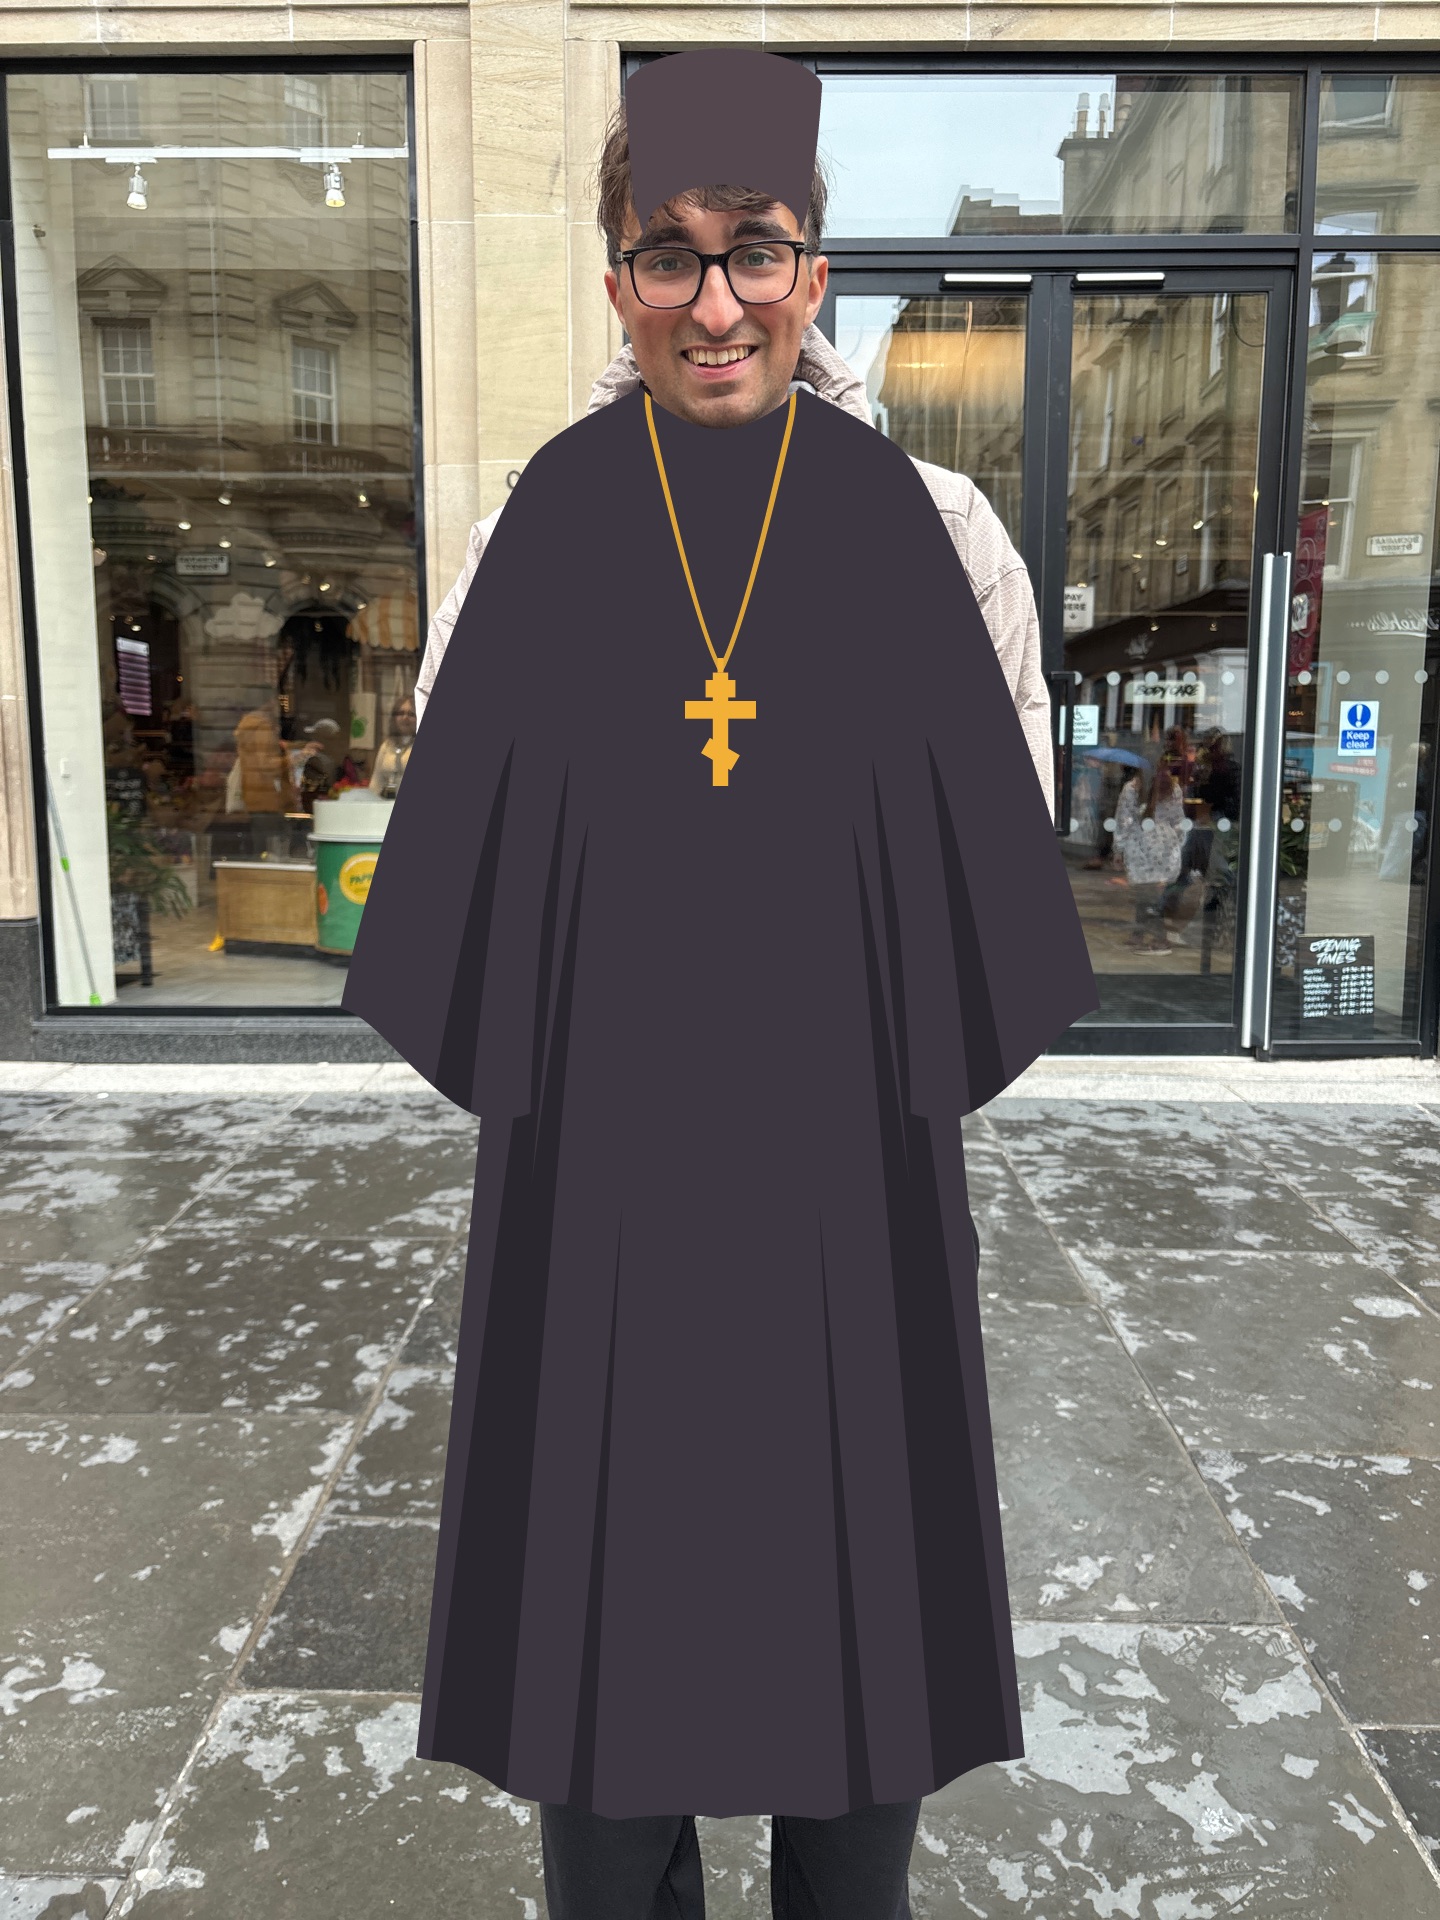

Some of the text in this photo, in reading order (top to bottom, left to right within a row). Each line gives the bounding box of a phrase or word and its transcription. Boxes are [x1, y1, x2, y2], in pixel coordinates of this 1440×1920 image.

[1346, 731, 1370, 741] Keep
[1346, 740, 1370, 749] clear
[1310, 938, 1361, 953] OPENING
[1316, 951, 1356, 965] TIMES
